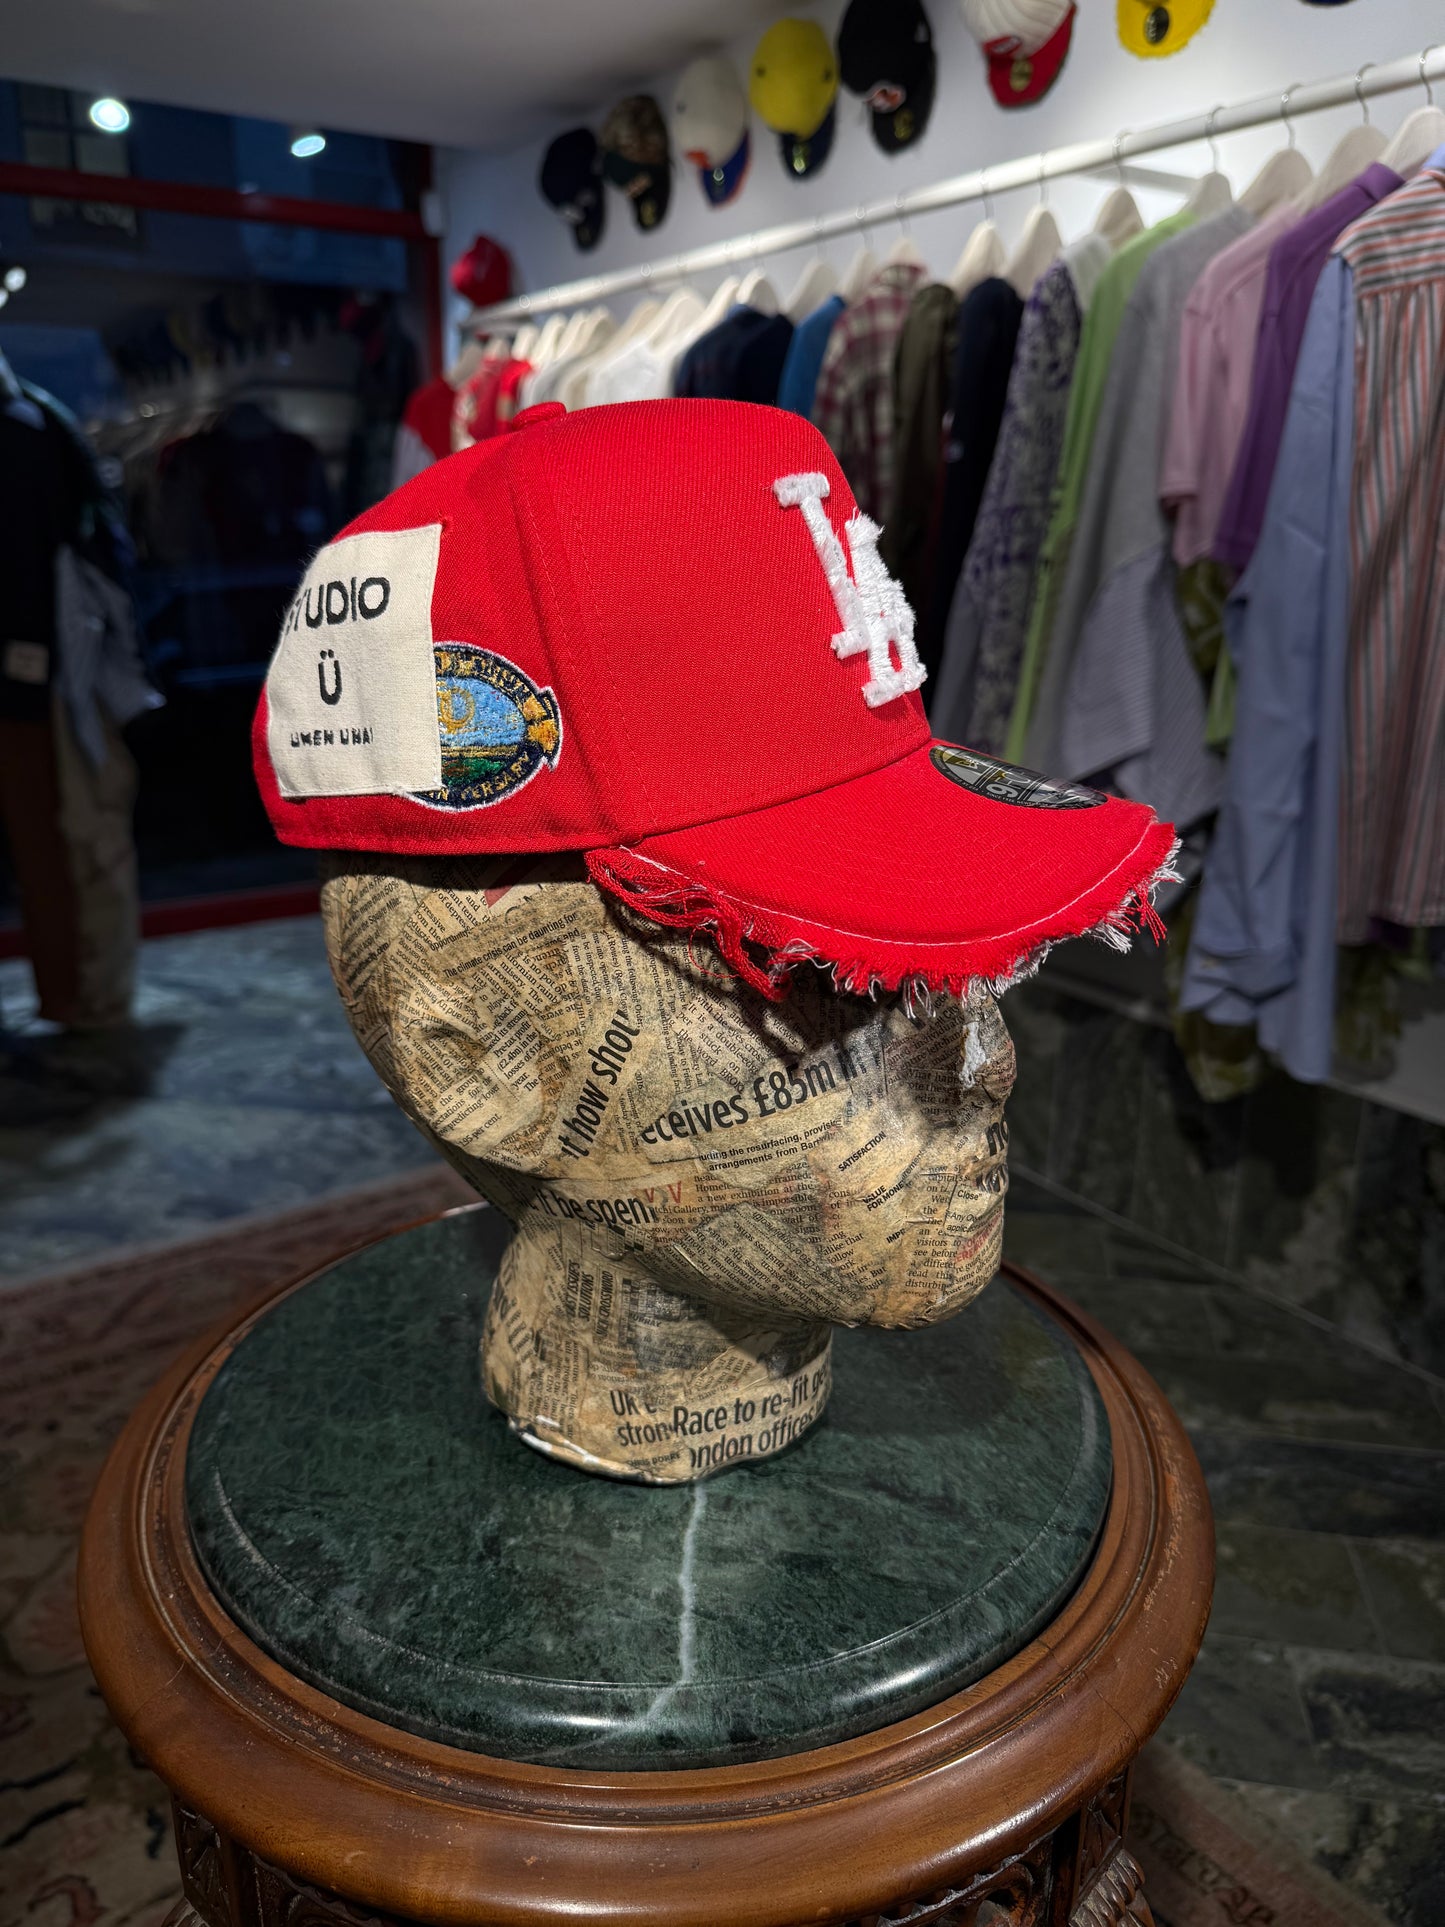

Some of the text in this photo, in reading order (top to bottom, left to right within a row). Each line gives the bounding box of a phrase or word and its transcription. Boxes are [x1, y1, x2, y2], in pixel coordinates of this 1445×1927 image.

[317, 649, 342, 706] Ü
[436, 891, 449, 904] of
[463, 894, 481, 911] and
[442, 908, 579, 979] The climate crisis can be daunting for
[582, 941, 590, 950] be
[521, 954, 555, 989] is no pot
[571, 944, 581, 962] from
[576, 964, 585, 976] the
[432, 983, 452, 1001] have
[497, 960, 544, 1005] misery. The
[624, 955, 640, 1003] the following
[402, 967, 461, 1021] and try families who
[687, 1003, 698, 1014] It
[696, 1012, 708, 1024] is
[706, 1022, 714, 1031] a
[693, 993, 714, 1014] with
[712, 1011, 729, 1028] the
[728, 1010, 747, 1028] and
[524, 1029, 538, 1043] the
[664, 1036, 674, 1050] and
[674, 1010, 741, 1074] per stuck on
[678, 1027, 695, 1044] the
[695, 1044, 719, 1067] word
[503, 1050, 533, 1080] losses of
[438, 1092, 455, 1107] the
[453, 1072, 481, 1096] group
[466, 1084, 482, 1099] for
[523, 1076, 540, 1092] The
[754, 1060, 837, 1119] £85m
[563, 1078, 611, 1143] how
[709, 1145, 799, 1172] arrangements from
[729, 1144, 745, 1158] the
[837, 1130, 888, 1173] SATISFACTION
[549, 1189, 588, 1222] be
[708, 1195, 727, 1203] new
[730, 1187, 780, 1202] exhibition
[797, 1182, 814, 1192] the
[862, 1184, 888, 1204] VALUE
[866, 1198, 885, 1212] FOR
[922, 1205, 938, 1215] the
[751, 1239, 785, 1270] business
[823, 1232, 865, 1256] alike that
[912, 1249, 928, 1258] see
[916, 1237, 948, 1248] visitors
[727, 1246, 781, 1292] to address the
[672, 1404, 729, 1438] Race
[733, 1396, 756, 1425] to
[761, 1375, 809, 1420] re-fit
